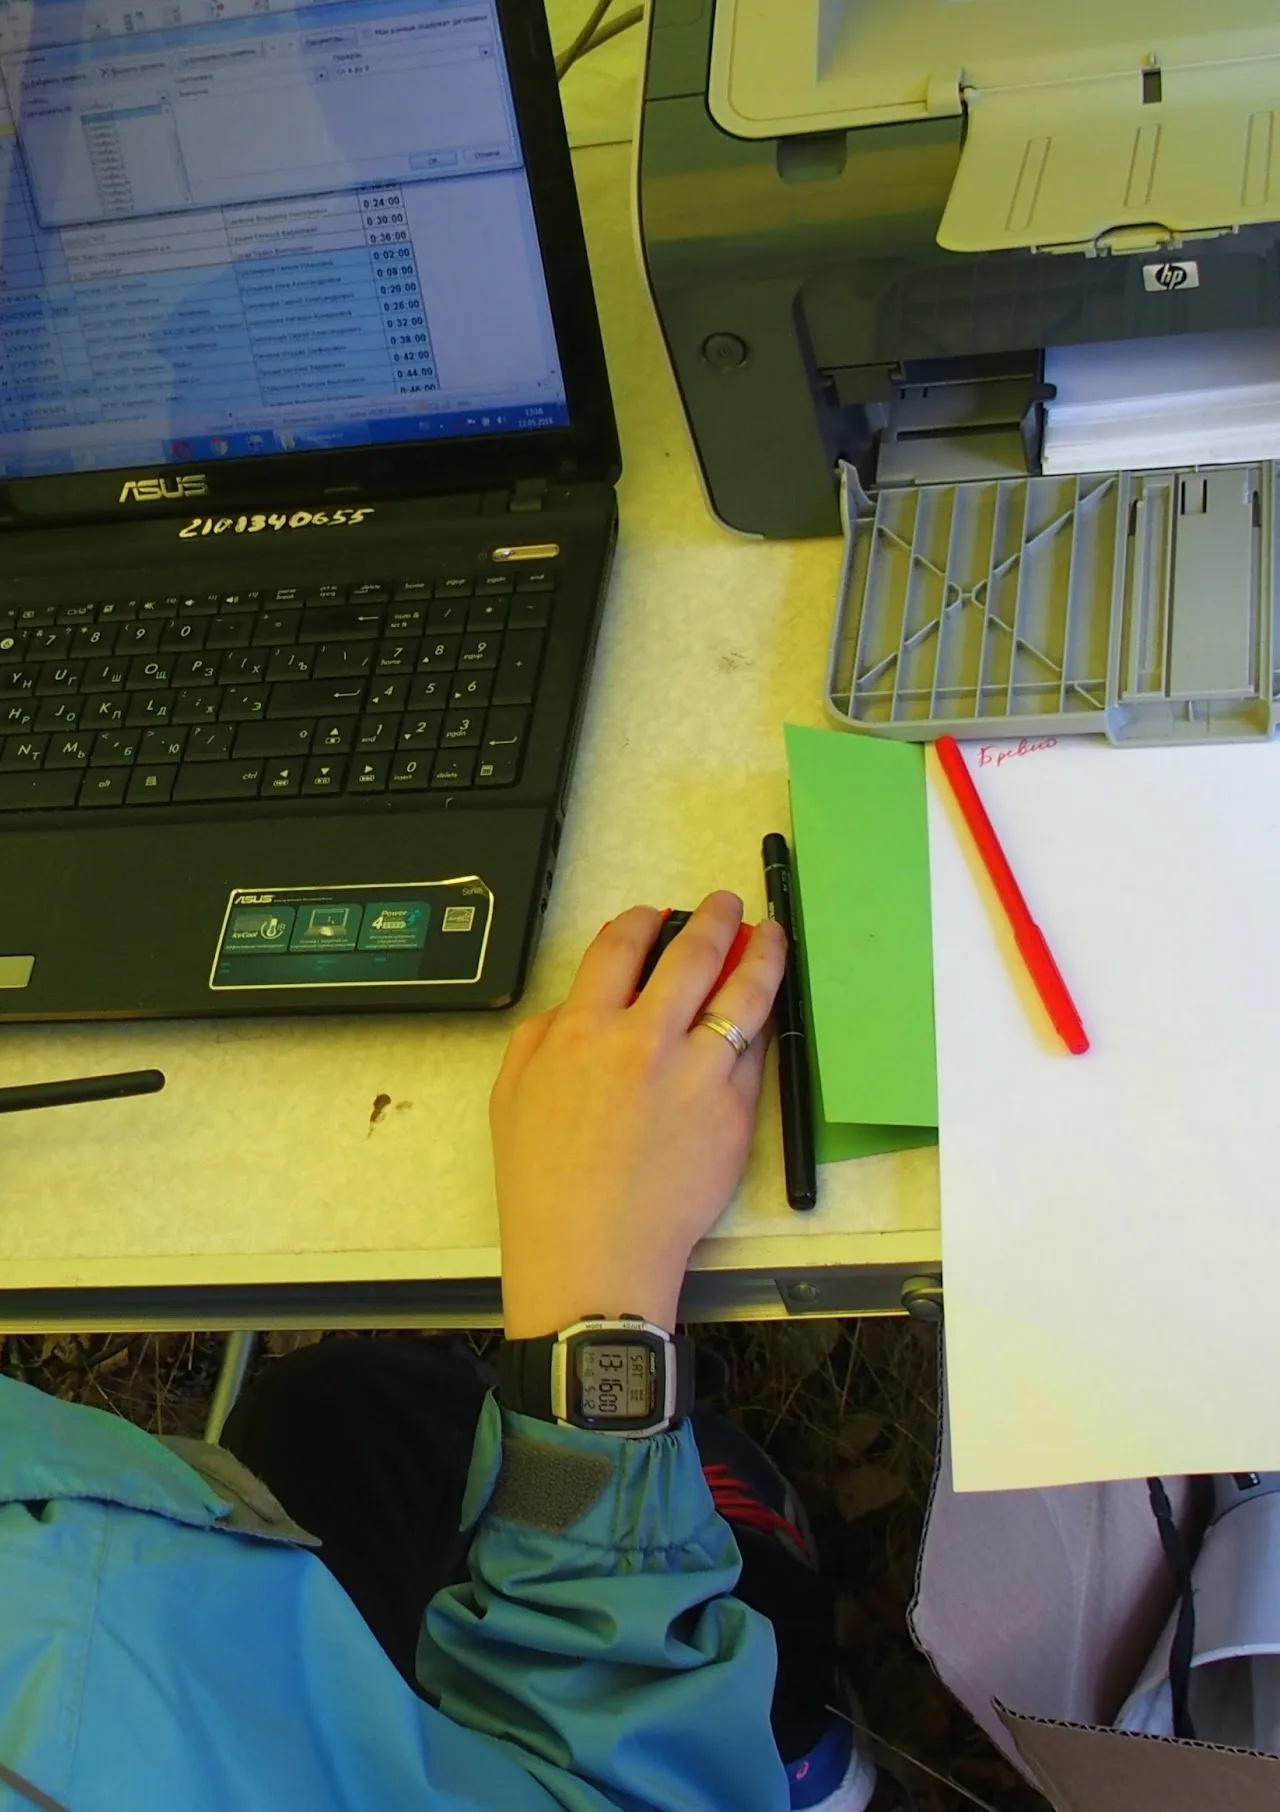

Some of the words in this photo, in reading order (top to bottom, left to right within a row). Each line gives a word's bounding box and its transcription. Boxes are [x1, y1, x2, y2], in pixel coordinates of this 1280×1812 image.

[1160, 264, 1184, 290] hp
[118, 474, 209, 503] ASUS
[234, 894, 275, 904] ASUS
